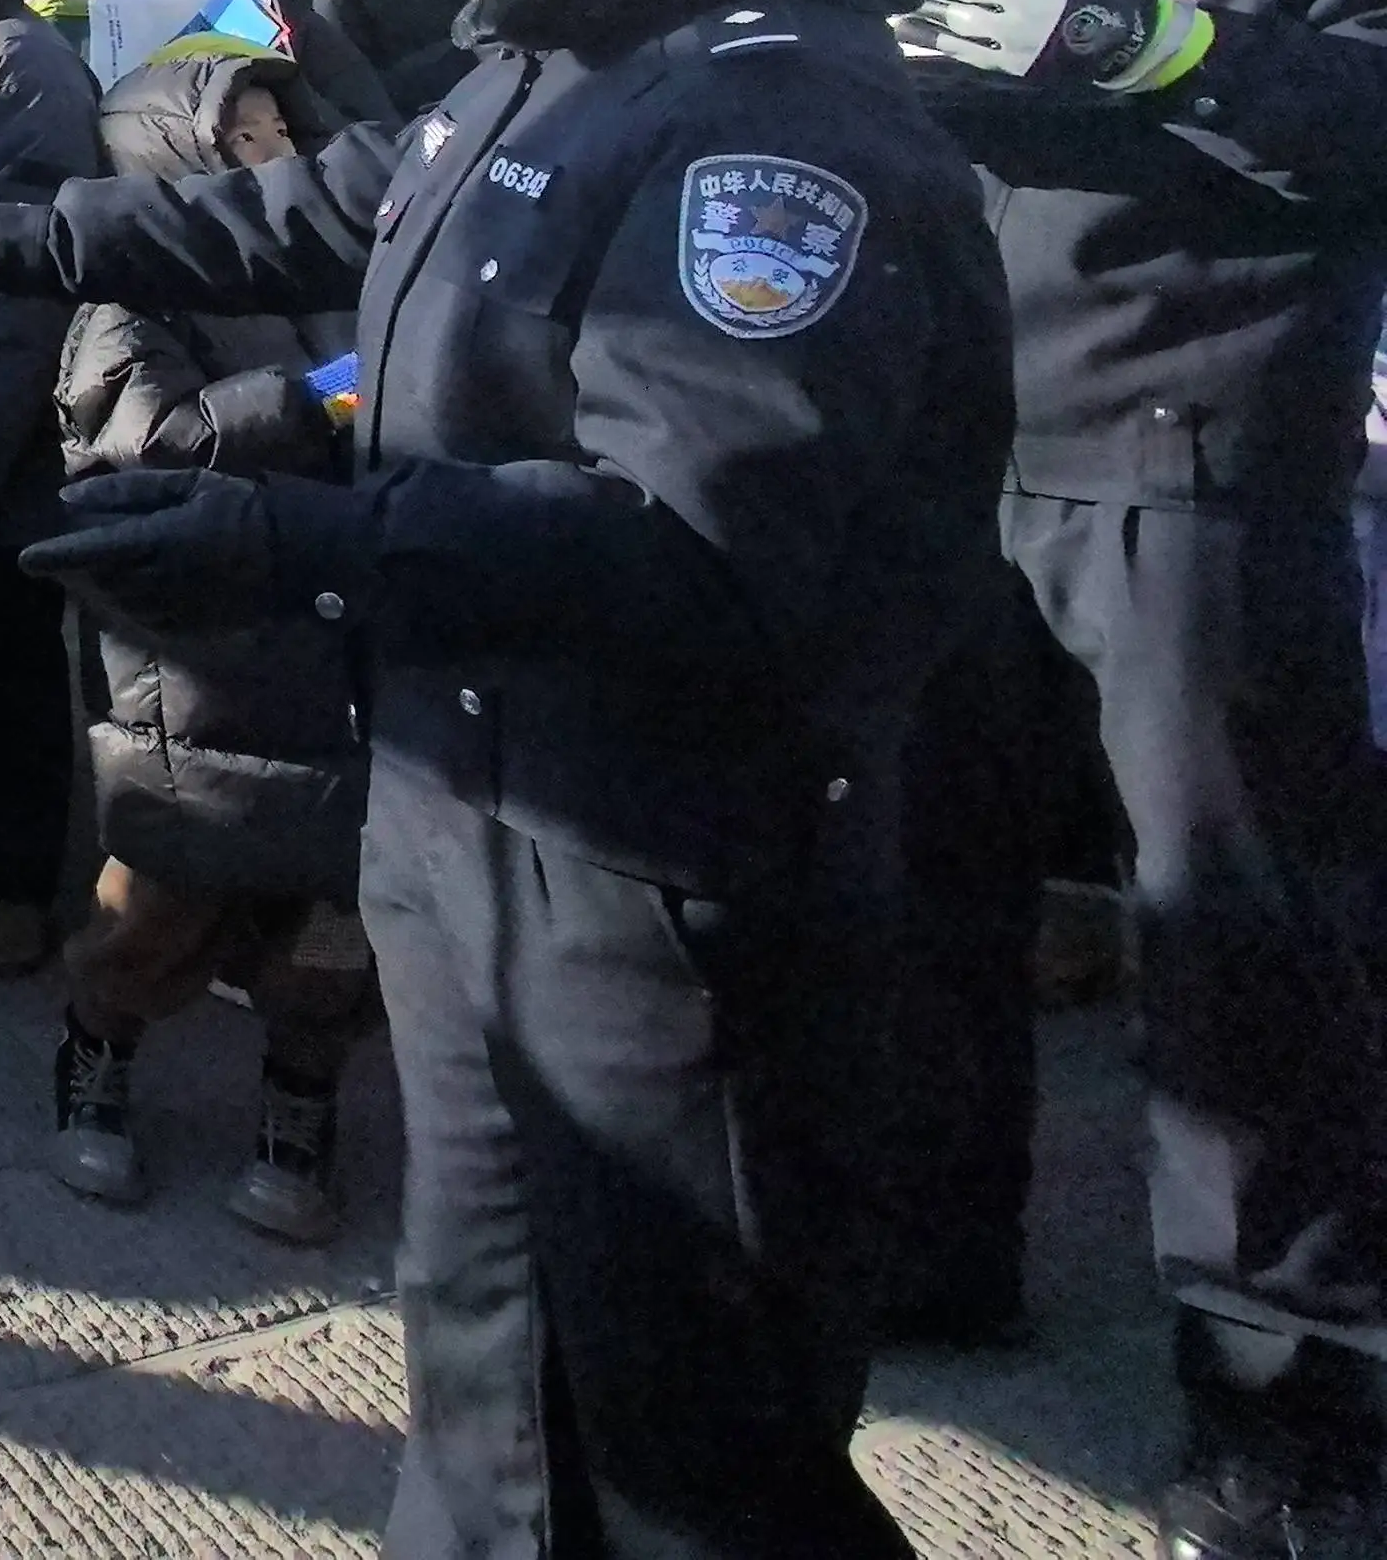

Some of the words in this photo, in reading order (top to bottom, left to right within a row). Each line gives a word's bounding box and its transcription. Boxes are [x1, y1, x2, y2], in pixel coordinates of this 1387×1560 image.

[699, 168, 856, 232] 中华人民共和国
